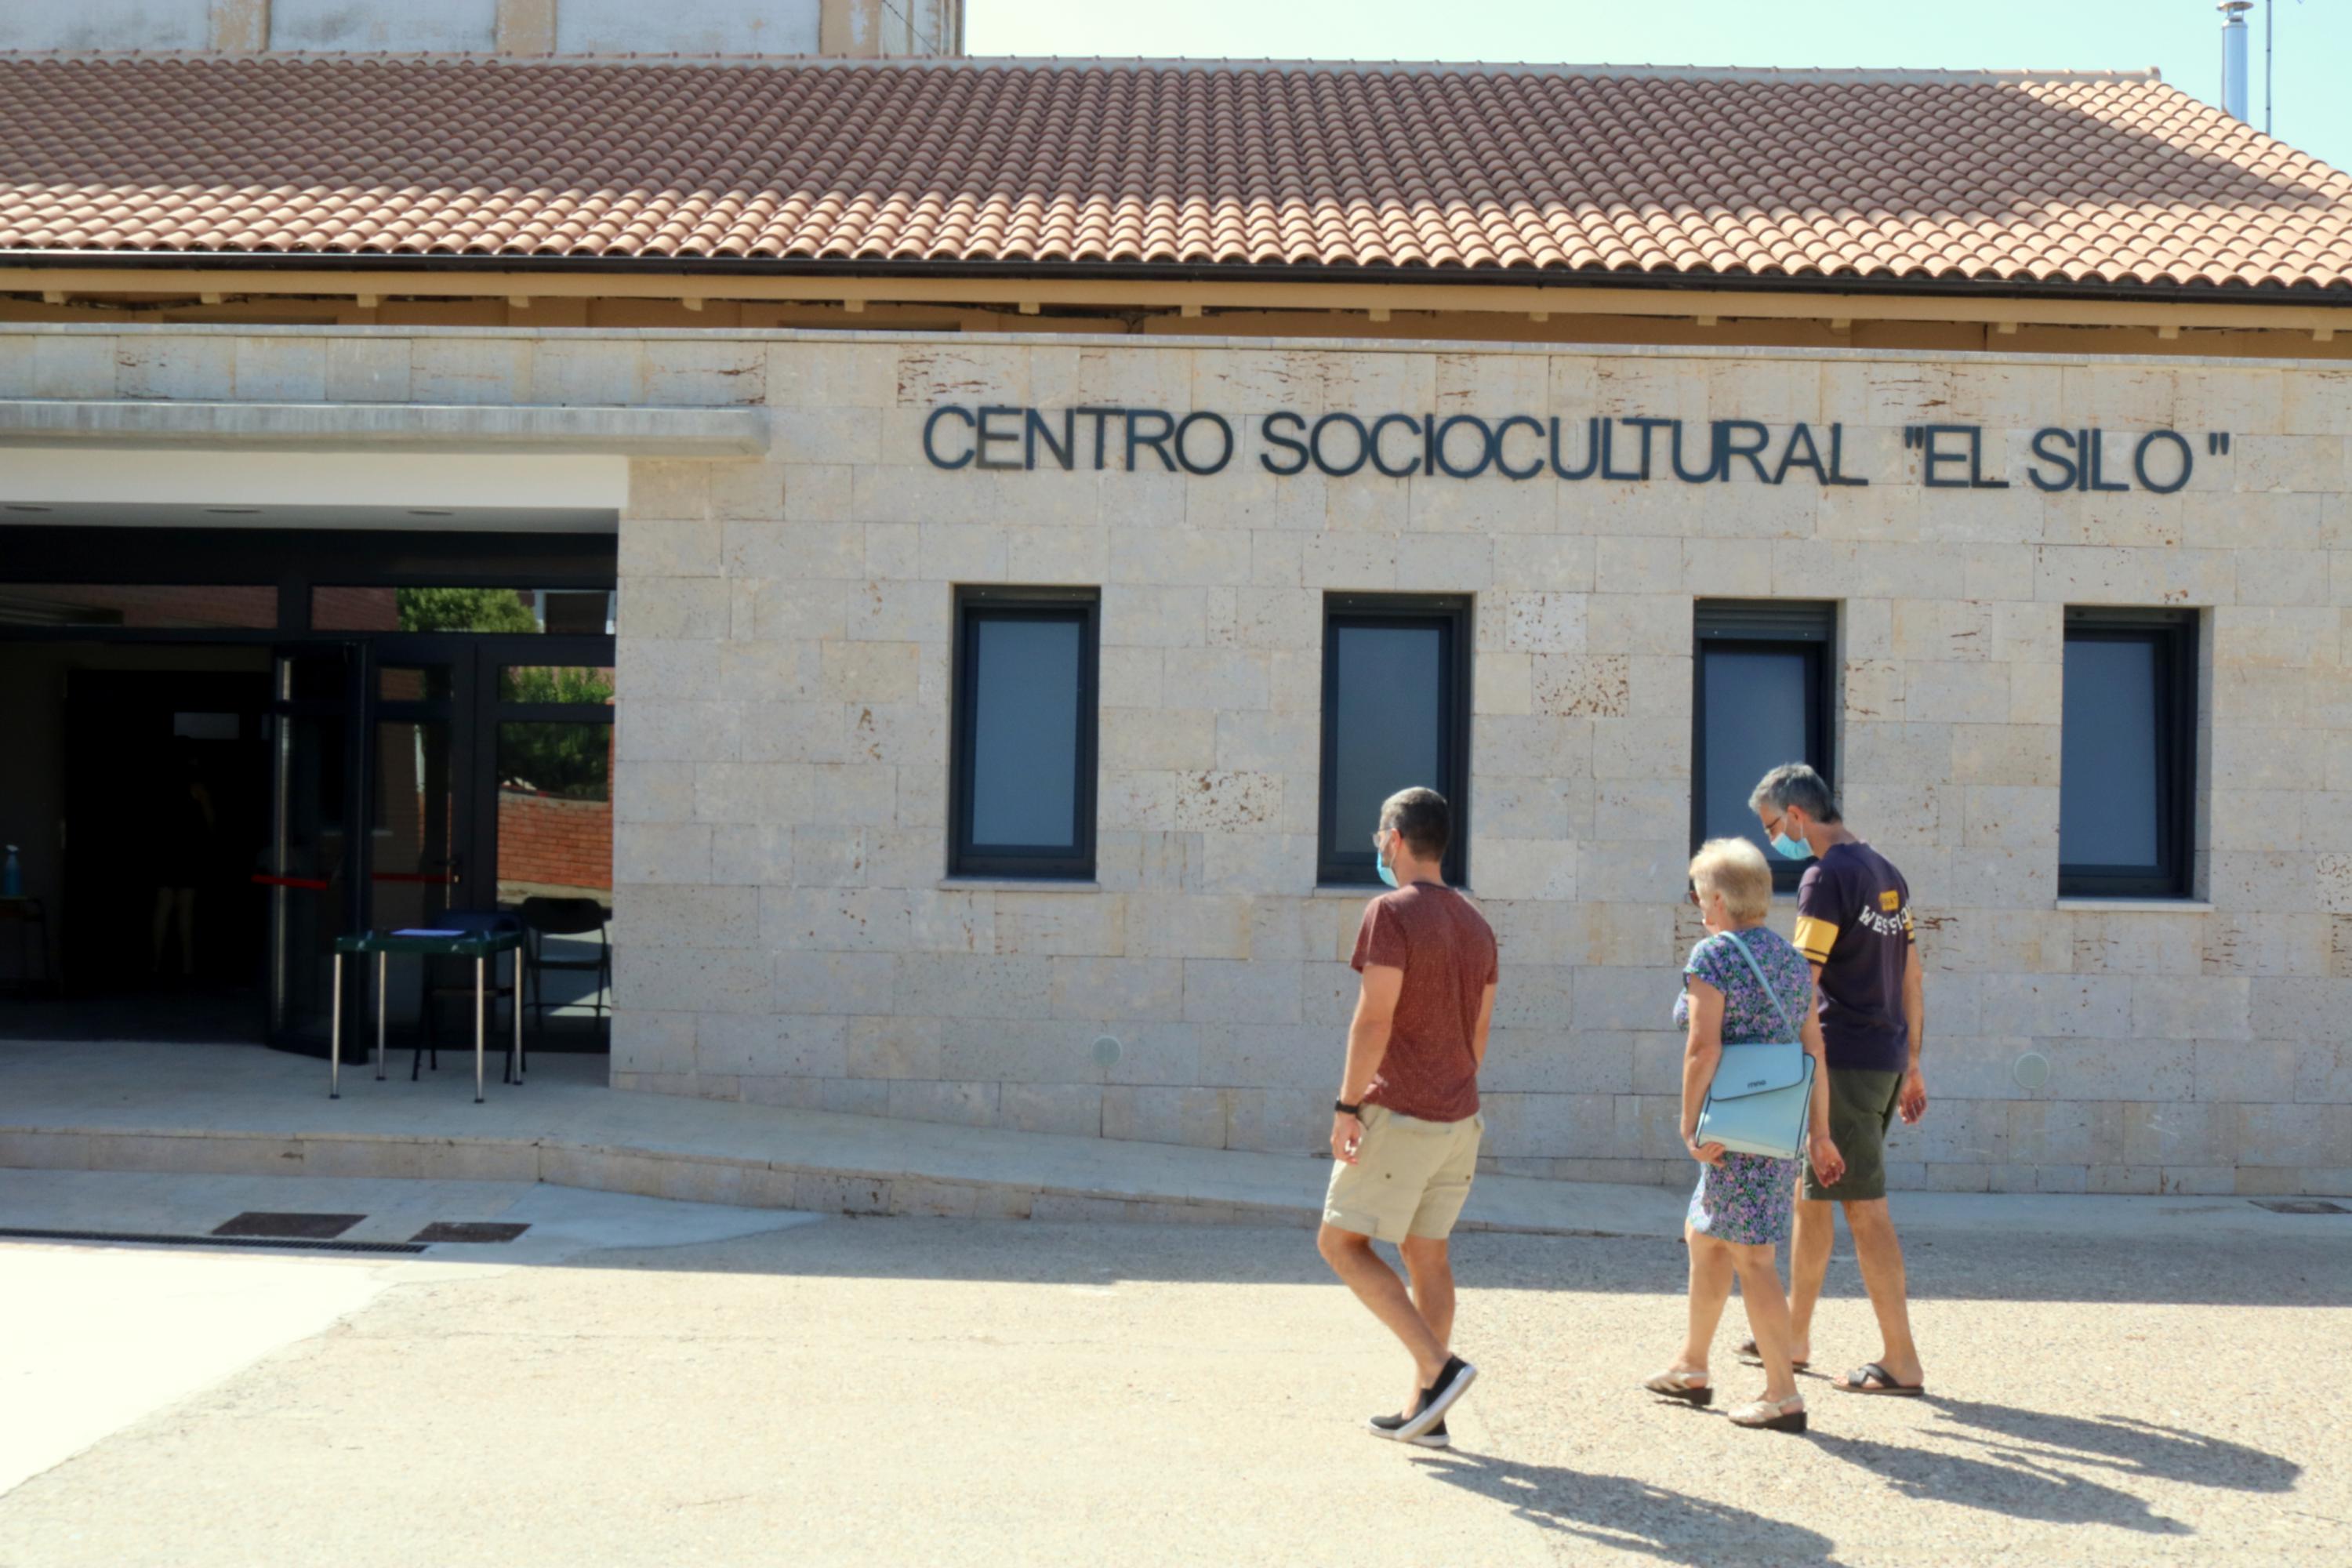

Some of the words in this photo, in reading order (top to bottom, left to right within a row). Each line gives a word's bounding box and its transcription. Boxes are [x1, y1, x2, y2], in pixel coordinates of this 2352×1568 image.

[923, 404, 1235, 477] CENTRO
[1259, 411, 1870, 487] SOCIOCULTURAL
[1904, 423, 2010, 489] "EL
